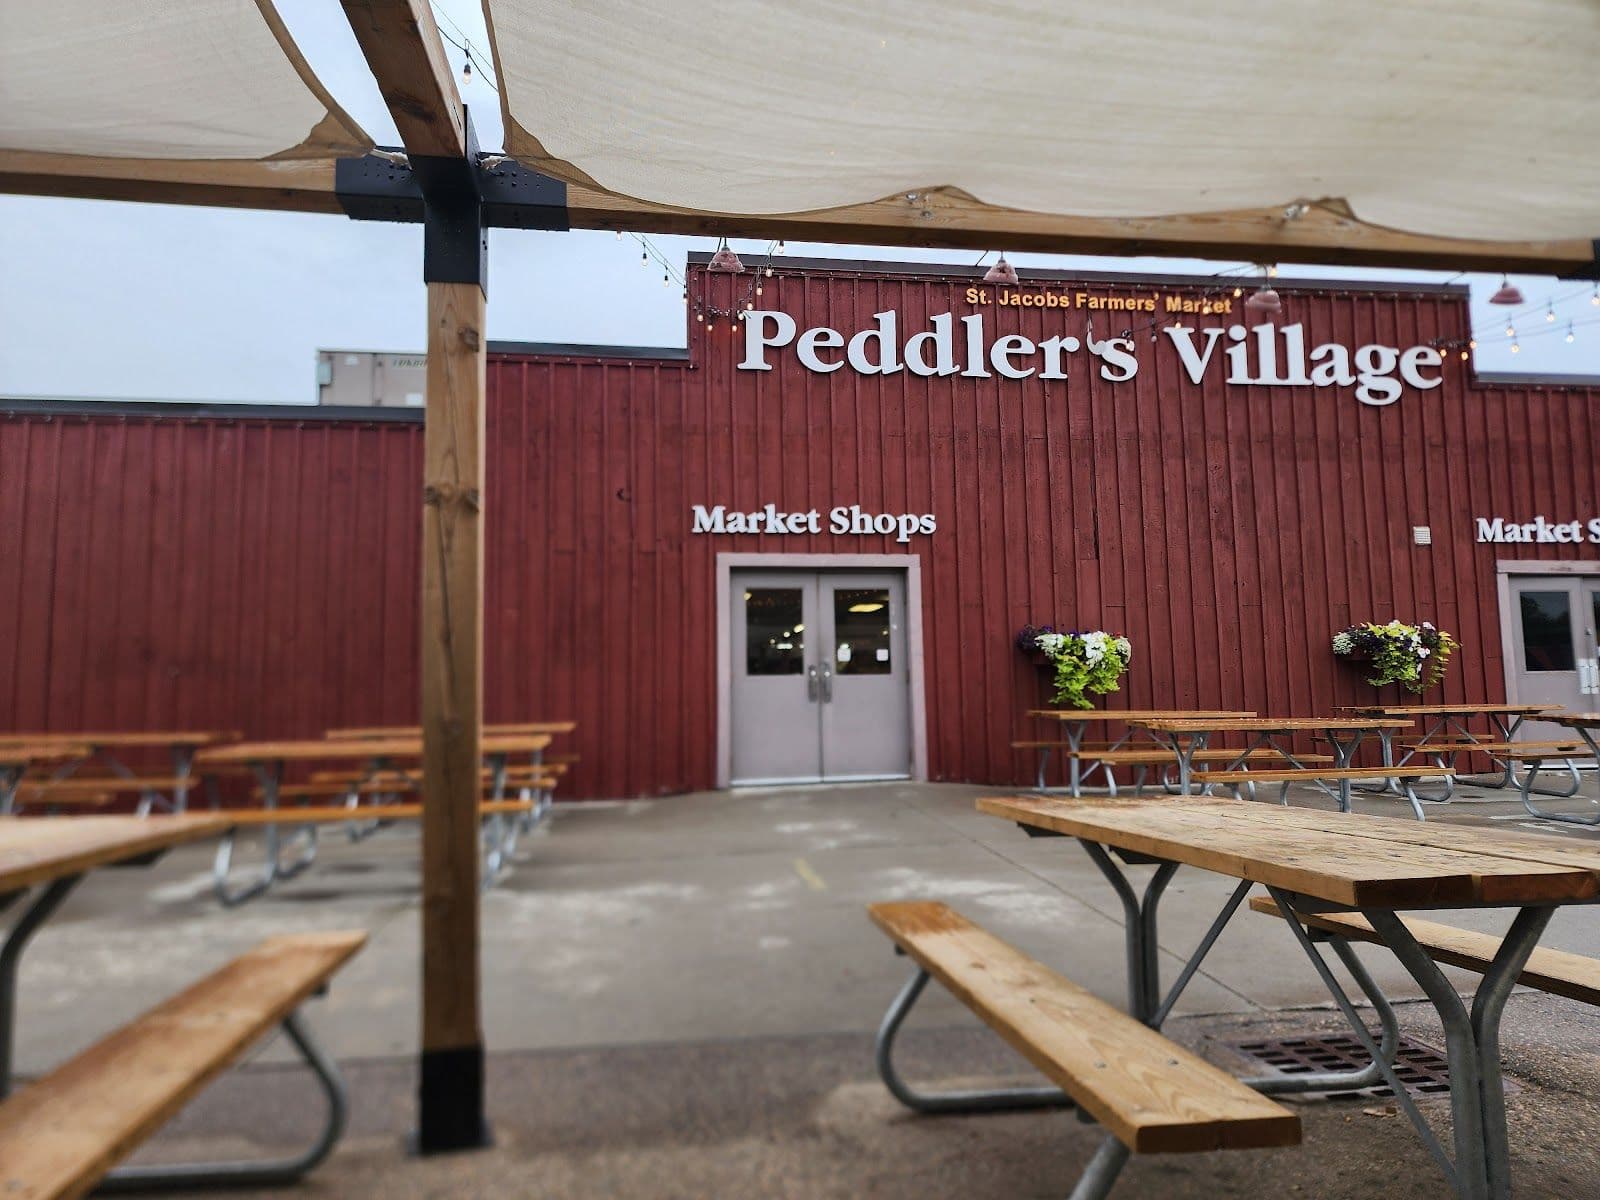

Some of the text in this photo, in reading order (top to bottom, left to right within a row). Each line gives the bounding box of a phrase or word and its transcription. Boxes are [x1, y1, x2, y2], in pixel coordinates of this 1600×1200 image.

[966, 288, 1232, 314] St. Jacobs Farmers' Market
[737, 309, 1443, 406] Peddler's Village
[692, 504, 936, 542] Market Shops
[1476, 515, 1584, 543] Market
